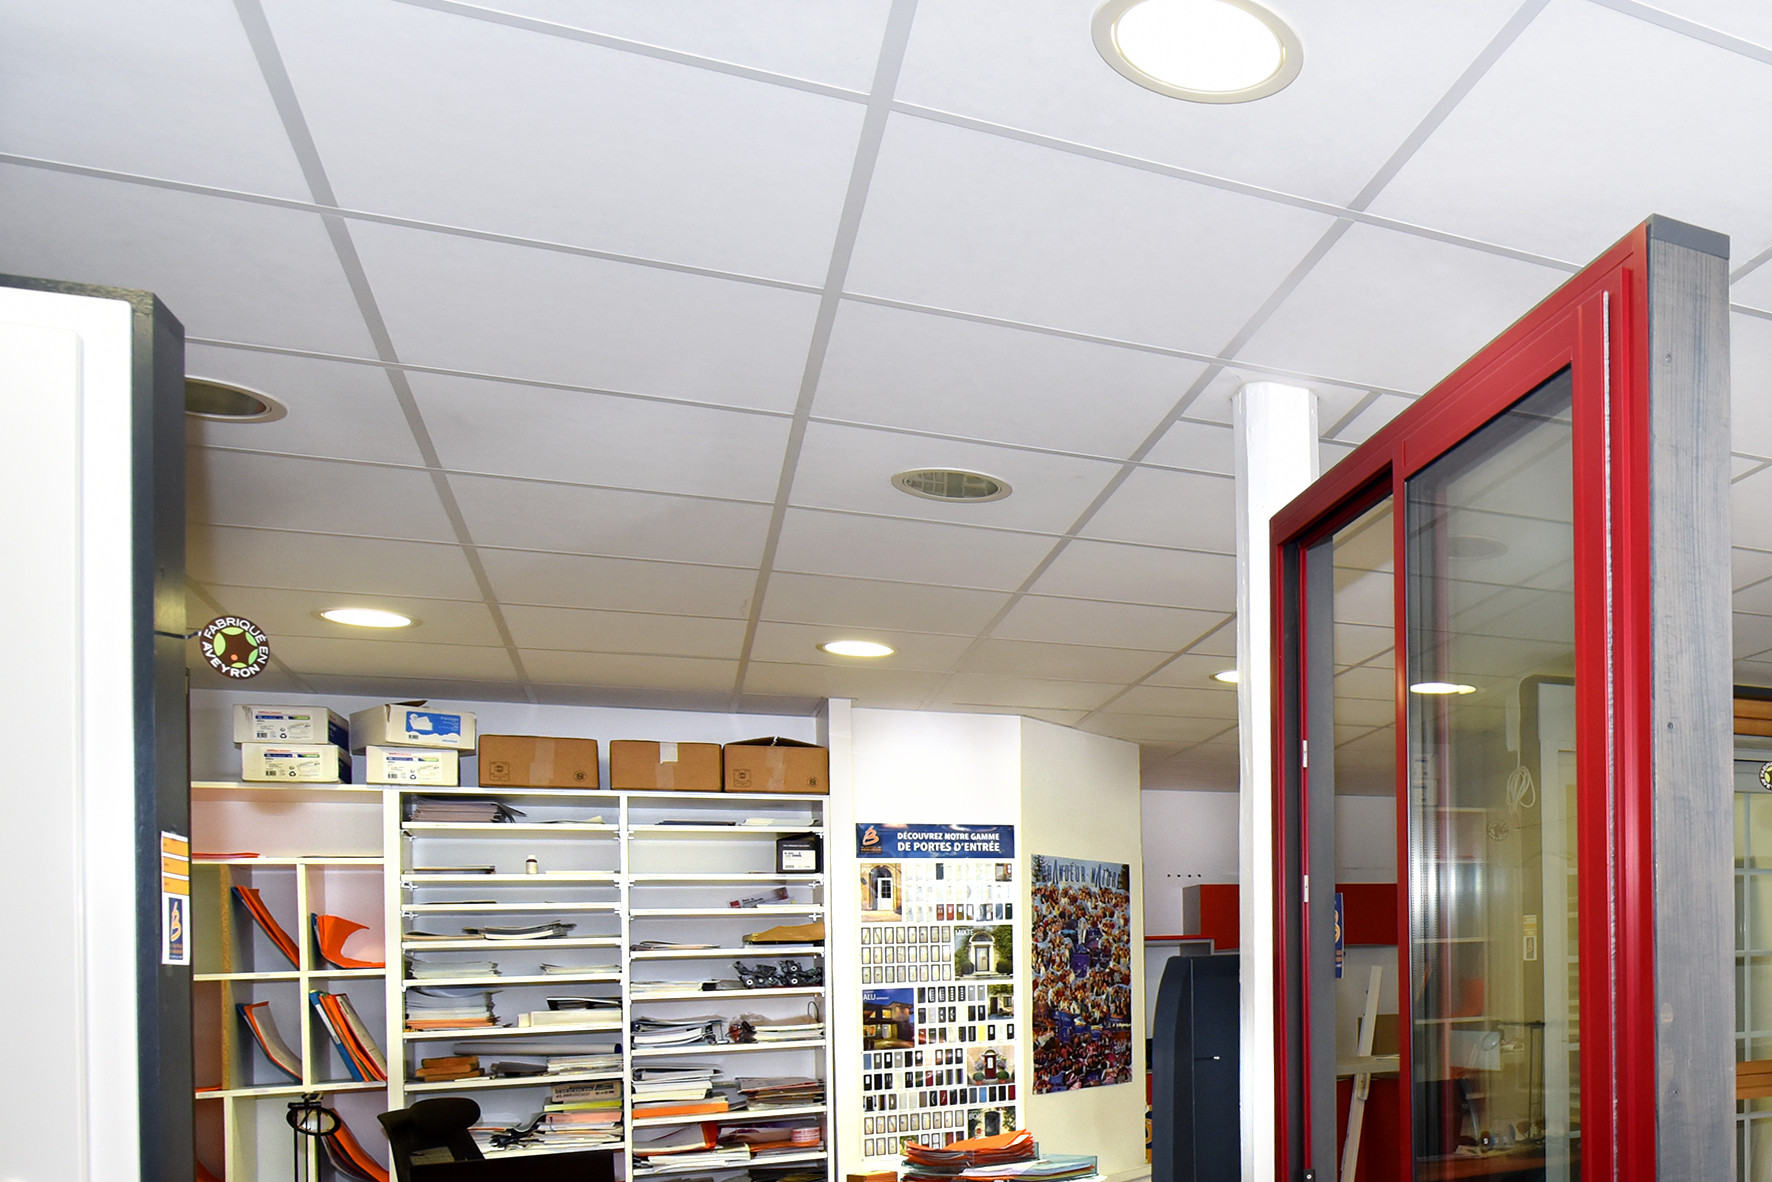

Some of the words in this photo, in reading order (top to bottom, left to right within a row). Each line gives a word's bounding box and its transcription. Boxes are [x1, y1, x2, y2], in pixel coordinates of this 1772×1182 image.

[203, 617, 268, 644] FABRIQUÉ
[202, 641, 261, 678] AVEYRON
[257, 646, 269, 664] EN
[897, 831, 943, 841] DÉCOUVREZ
[944, 831, 969, 841] NOTRE
[970, 832, 1000, 841] GAMME
[897, 842, 911, 852] DE
[913, 842, 952, 852] PORTES
[953, 841, 1000, 852] D'ENTRÉE
